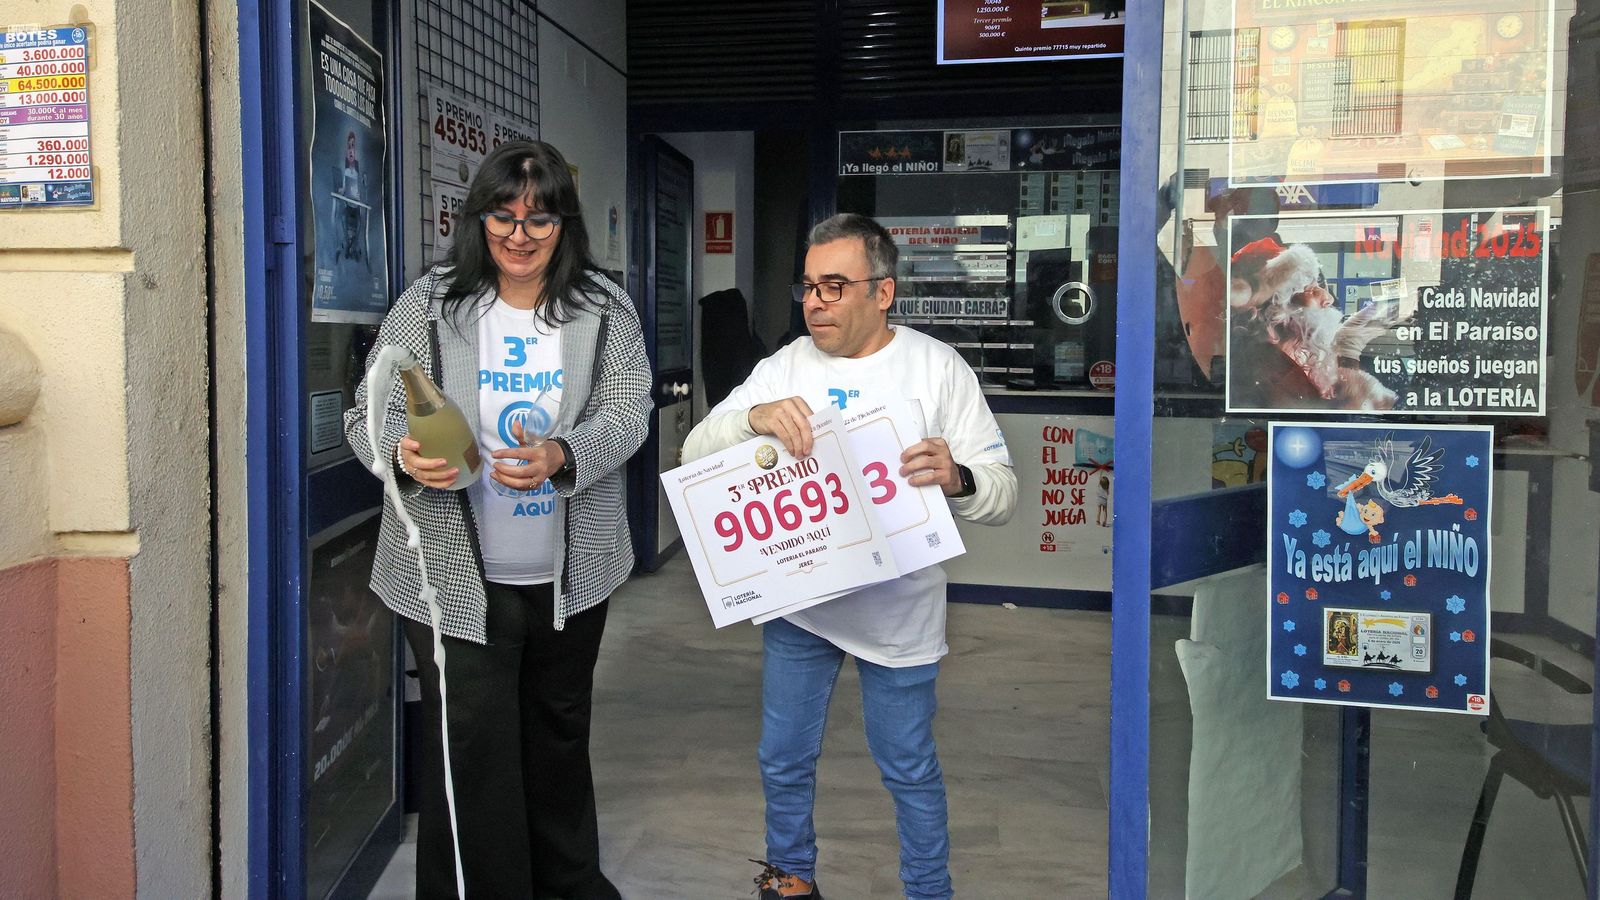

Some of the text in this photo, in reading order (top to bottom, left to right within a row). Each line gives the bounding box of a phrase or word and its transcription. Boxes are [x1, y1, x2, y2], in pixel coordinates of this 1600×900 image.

[992, 16, 1012, 24] premio
[6, 29, 58, 42] BOTES
[23, 47, 84, 61] 3.600.000
[321, 51, 330, 72] ES
[16, 62, 84, 76] 40.000.000
[18, 76, 85, 90] 64.500.000
[19, 91, 86, 105] 13.000.000
[27, 106, 56, 115] 30.000€
[436, 97, 482, 129] 5 PREMIO
[434, 114, 487, 156] 45353
[37, 138, 88, 151] 360.000
[27, 153, 88, 165] 1.290.000
[862, 162, 889, 174] llegó
[892, 162, 902, 172] el
[906, 160, 938, 172] NIÑO!
[48, 168, 90, 179] 12.000
[933, 226, 979, 235] VIAJERA
[909, 235, 958, 245] DEL NIÑO
[1474, 220, 1541, 259] 2025
[1422, 286, 1540, 309] Cada Navidad
[922, 300, 962, 314] CIUDAD
[964, 298, 1006, 314] CAERÁ?
[1396, 320, 1538, 342] en El Paraíso
[1095, 364, 1112, 374] +18
[1374, 356, 1538, 380] tus sueños juegan
[1406, 384, 1536, 408] a la LOTERÍA
[1042, 425, 1074, 444] CON
[1042, 446, 1058, 464] EL
[747, 457, 820, 495] PREMIO
[1042, 467, 1088, 486] JUEGO
[1042, 487, 1086, 506] NO SE
[714, 472, 849, 552] 90693
[1042, 508, 1086, 526] JUEGA
[760, 524, 831, 557] VENDIDO AQUÍ
[1282, 522, 1479, 586] Ya está aquí el NIÑO
[798, 560, 813, 569] JEREZ
[734, 590, 755, 601] LOTERÍA
[736, 594, 762, 605] NACIONAL
